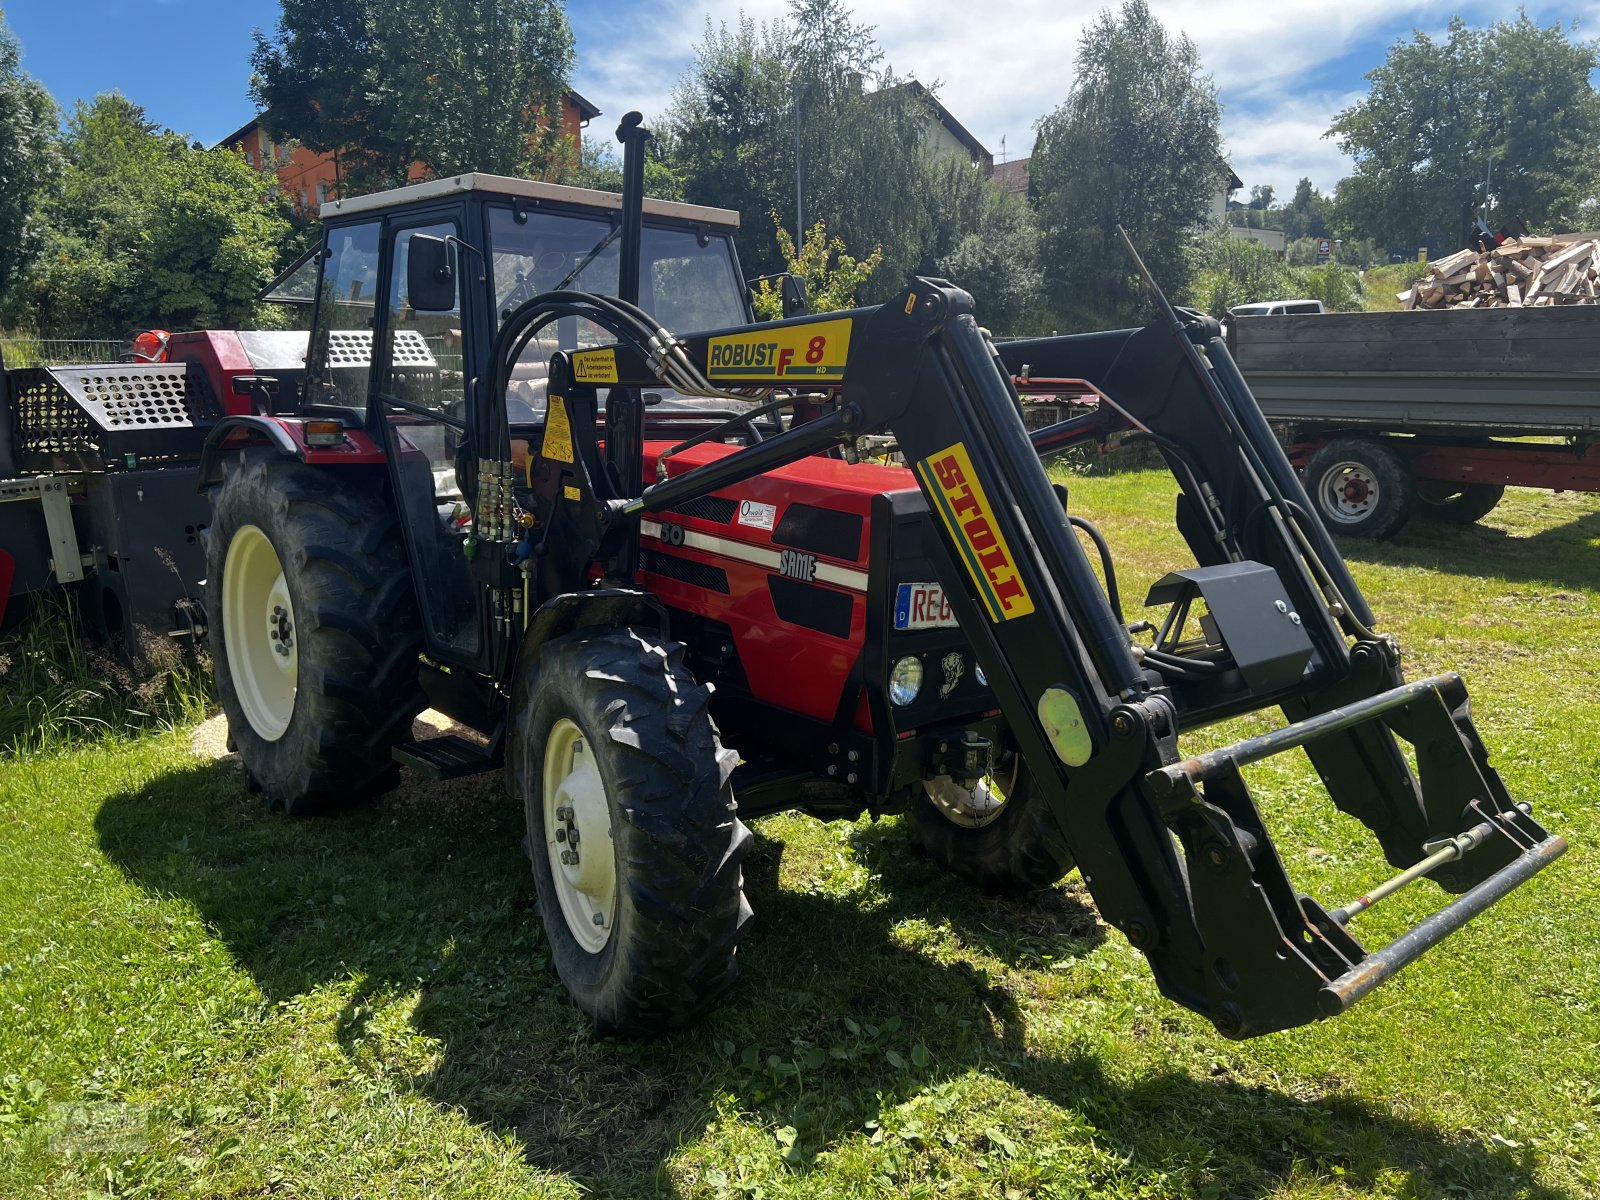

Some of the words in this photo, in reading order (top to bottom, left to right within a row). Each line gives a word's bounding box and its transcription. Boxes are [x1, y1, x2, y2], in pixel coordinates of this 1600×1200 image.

[710, 343, 778, 366] ROBUST
[777, 348, 795, 376] F
[805, 335, 826, 364] 8
[816, 366, 827, 374] HD
[661, 522, 686, 546] 50
[932, 454, 1025, 611] STOLL
[779, 549, 817, 582] SAME
[899, 611, 906, 621] D
